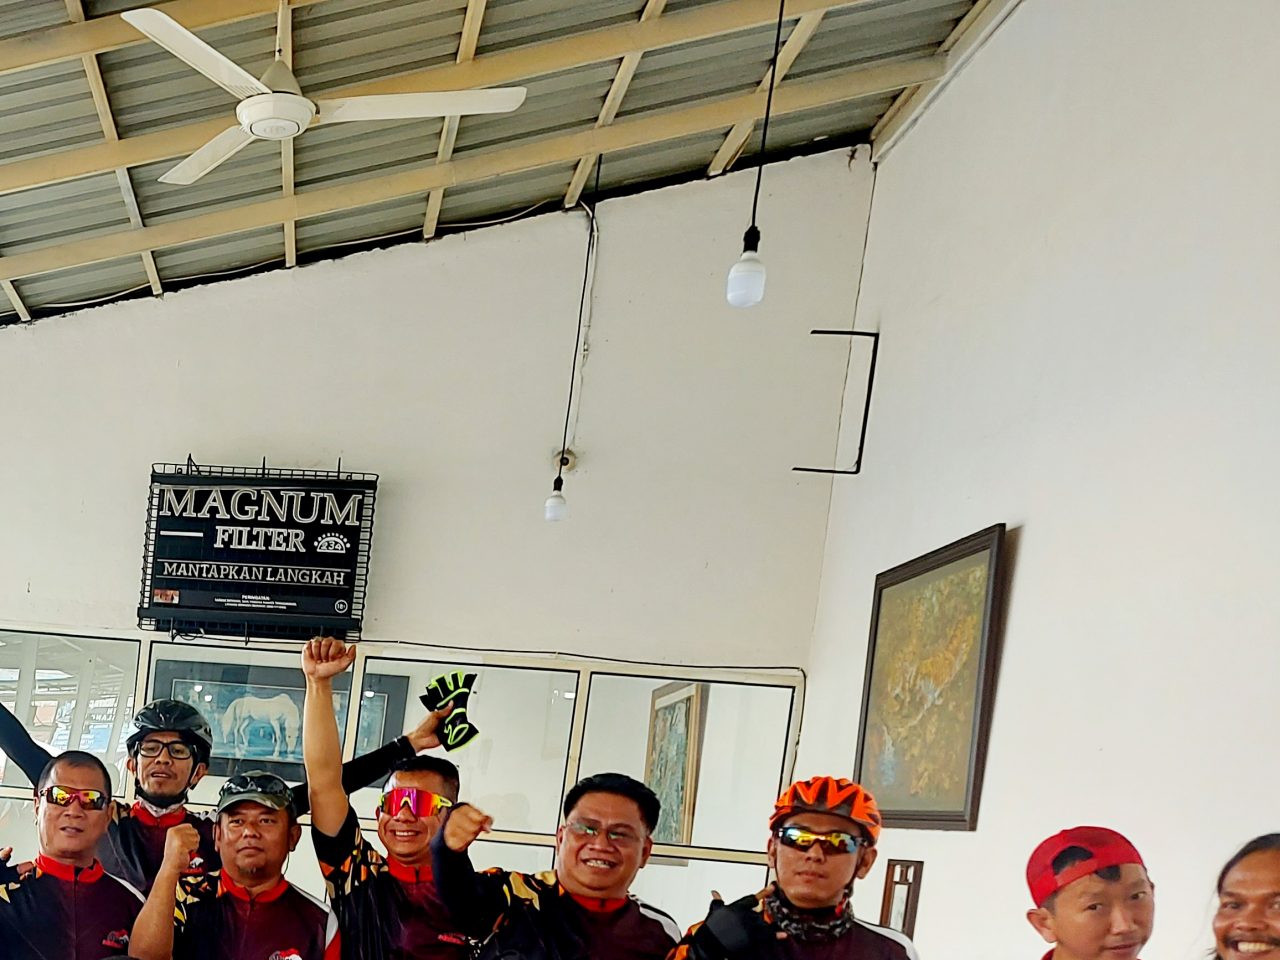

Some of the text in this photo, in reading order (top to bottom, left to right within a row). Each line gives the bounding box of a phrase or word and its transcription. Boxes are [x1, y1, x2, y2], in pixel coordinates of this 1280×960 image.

[159, 488, 363, 526] MAGNUM
[213, 525, 306, 553] FILTER
[320, 541, 342, 551] 234
[163, 562, 345, 585] MANTAPKAN LANGKAH
